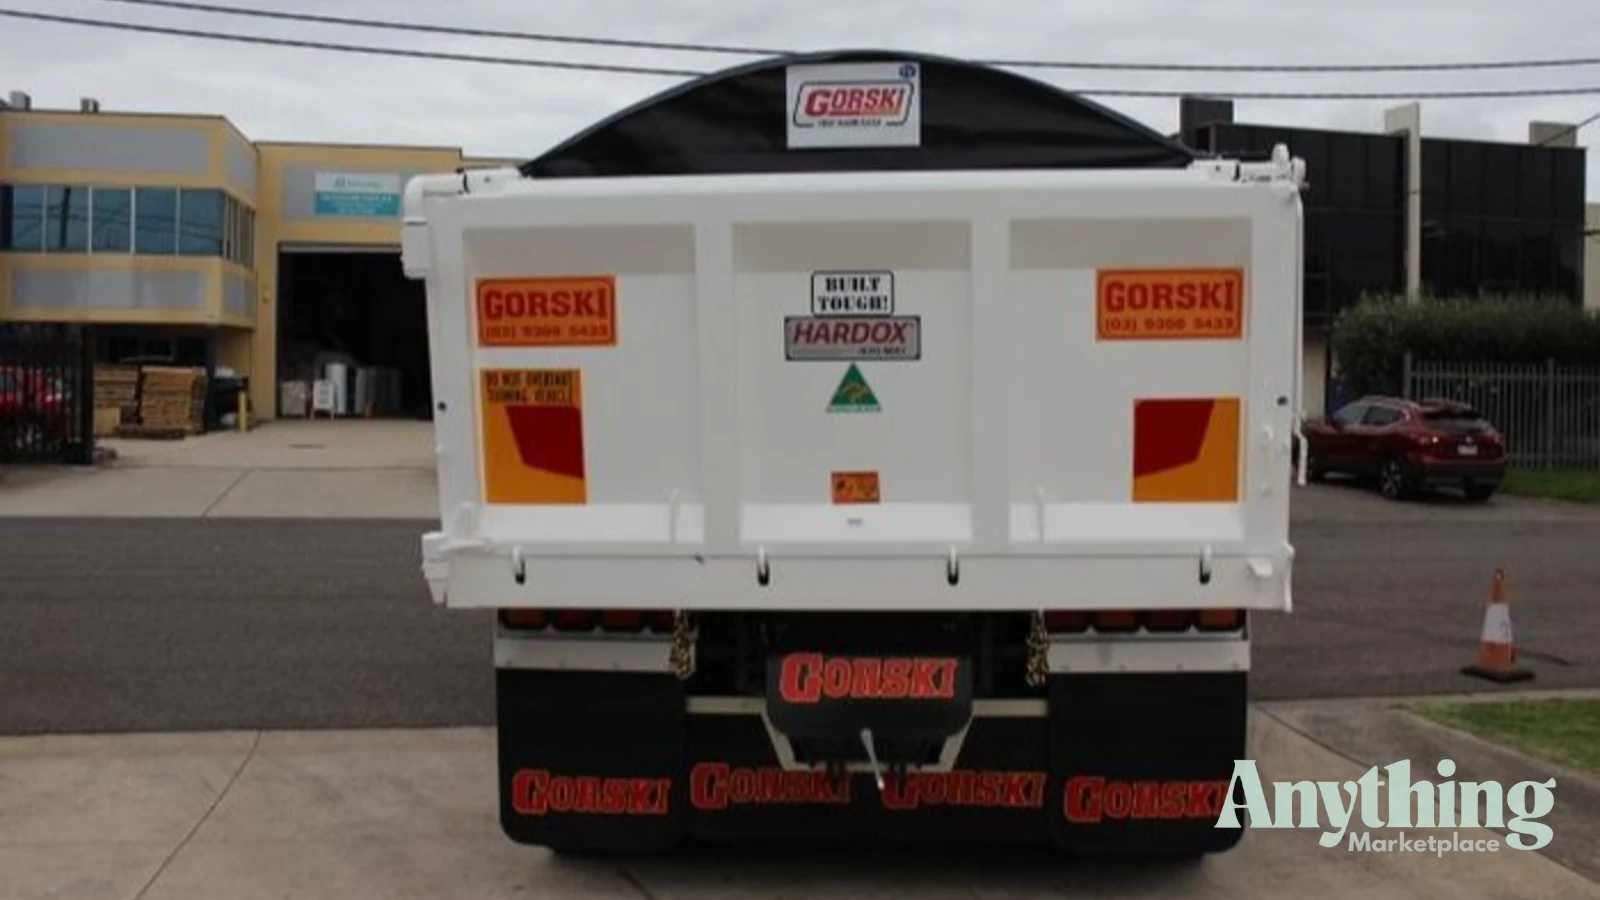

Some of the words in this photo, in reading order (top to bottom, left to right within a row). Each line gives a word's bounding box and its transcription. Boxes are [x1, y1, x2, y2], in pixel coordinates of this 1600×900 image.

[804, 87, 905, 117] GORSKI
[824, 277, 881, 292] BUILT
[1105, 280, 1235, 312] GORSKI
[484, 287, 608, 320] GORSKI
[818, 295, 888, 311] TOUGH!
[794, 321, 908, 344] HARDOX
[1105, 317, 1137, 333] (03)
[780, 652, 958, 703] GORSKI
[512, 768, 671, 816] GORSKI
[690, 761, 852, 809] GORSKI
